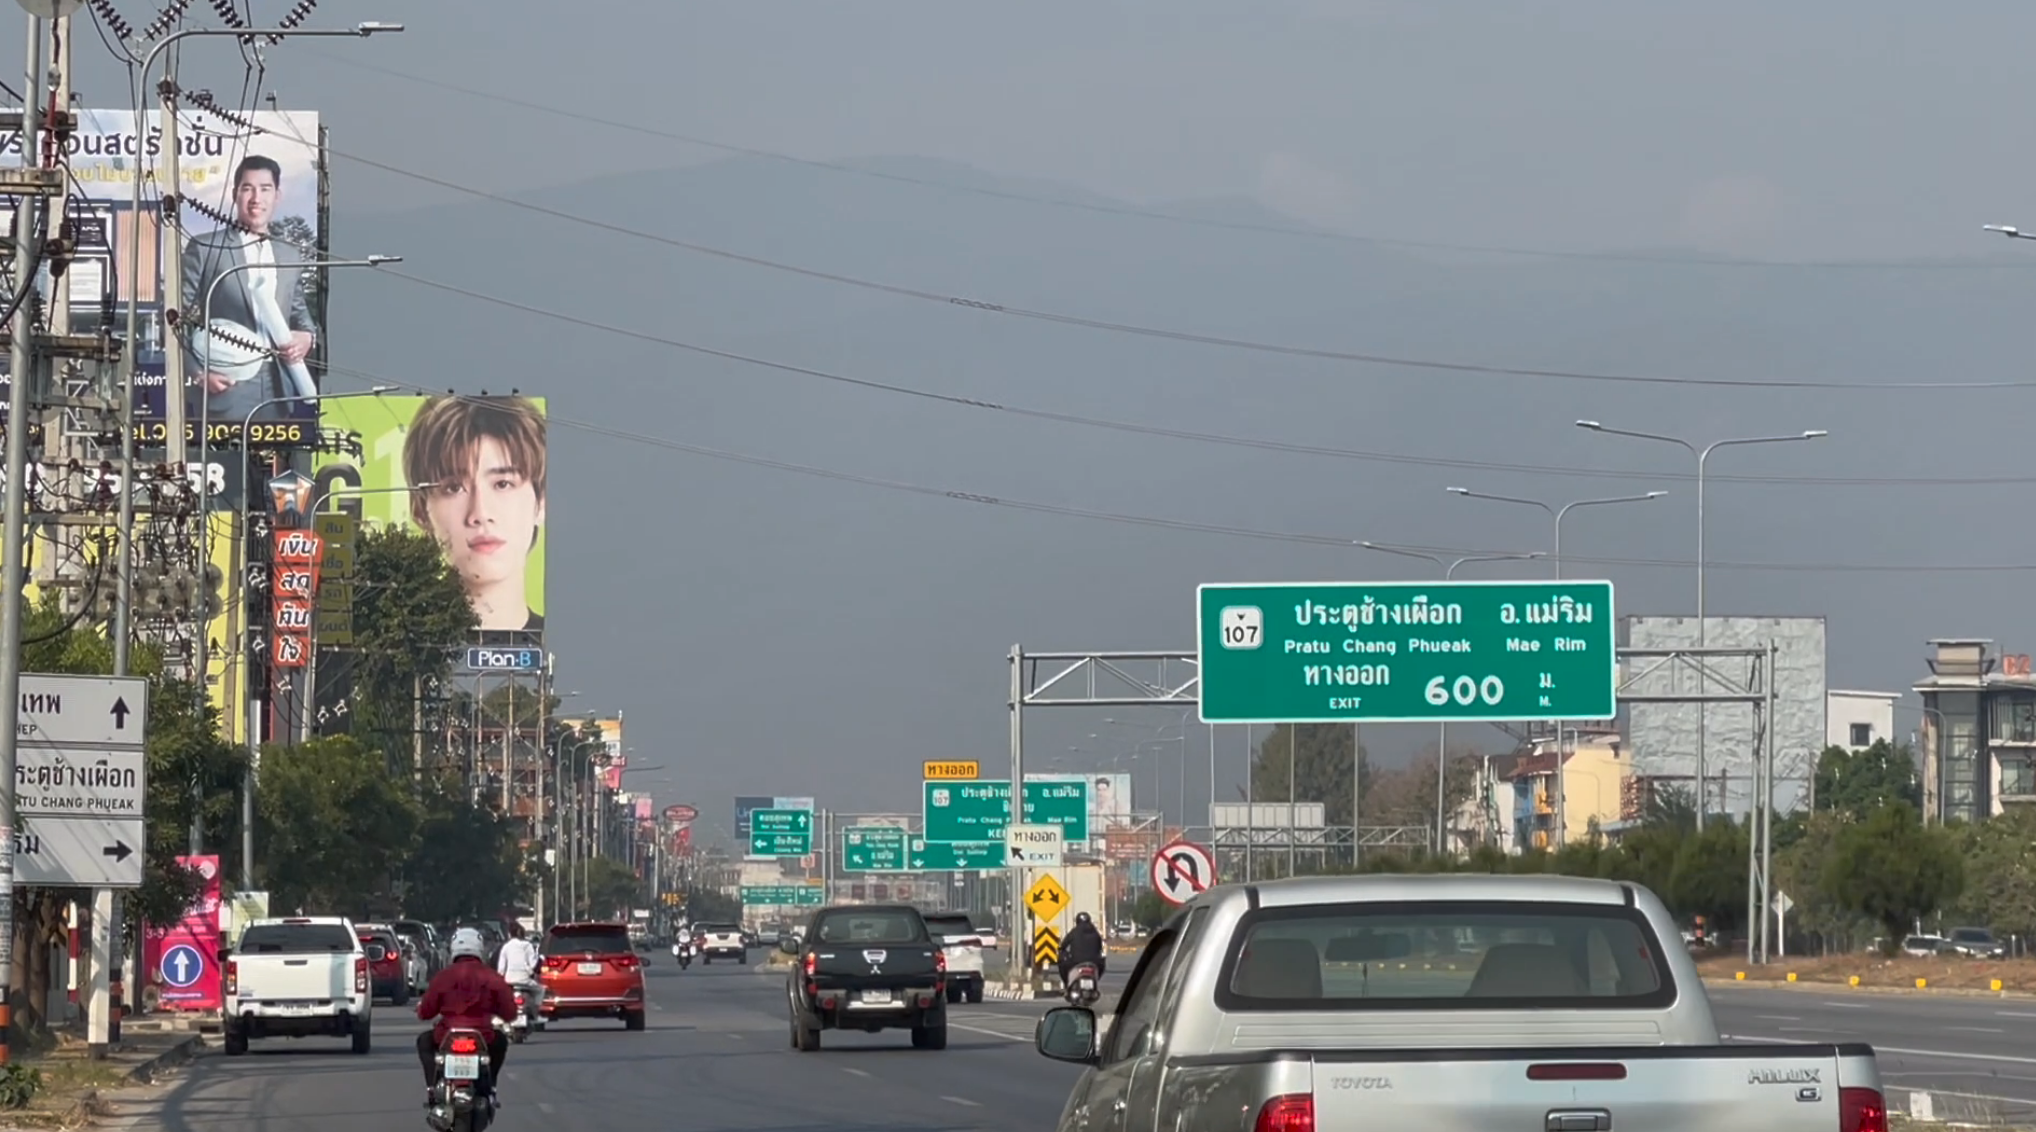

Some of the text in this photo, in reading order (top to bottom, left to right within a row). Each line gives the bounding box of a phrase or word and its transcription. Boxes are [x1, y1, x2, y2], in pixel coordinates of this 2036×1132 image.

[251, 424, 301, 441] 9256
[278, 533, 318, 557] เงิน
[279, 573, 311, 591] สด
[1295, 595, 1592, 632] ประตูช้างเผือก อ.แม่ริม
[1225, 626, 1258, 643] 107
[278, 635, 301, 661] ใจ
[1284, 637, 1586, 656] Pratu Chang Phueak Mae Rim
[1303, 664, 1390, 686] ทางออก
[1539, 672, 1556, 688] ม.
[1424, 674, 1504, 705] 600
[1329, 697, 1361, 709] EXIT
[1539, 695, 1552, 707] M.
[14, 757, 135, 791] ระตูช้างเผือก
[927, 764, 975, 776] ทางออก
[41, 797, 83, 808] CHANG
[87, 798, 135, 810] PHUEAK
[1014, 831, 1057, 843] ทางออก
[1029, 853, 1055, 861] EXIT
[1331, 1076, 1393, 1089] TOYOTA
[1747, 1068, 1821, 1084] HILUX
